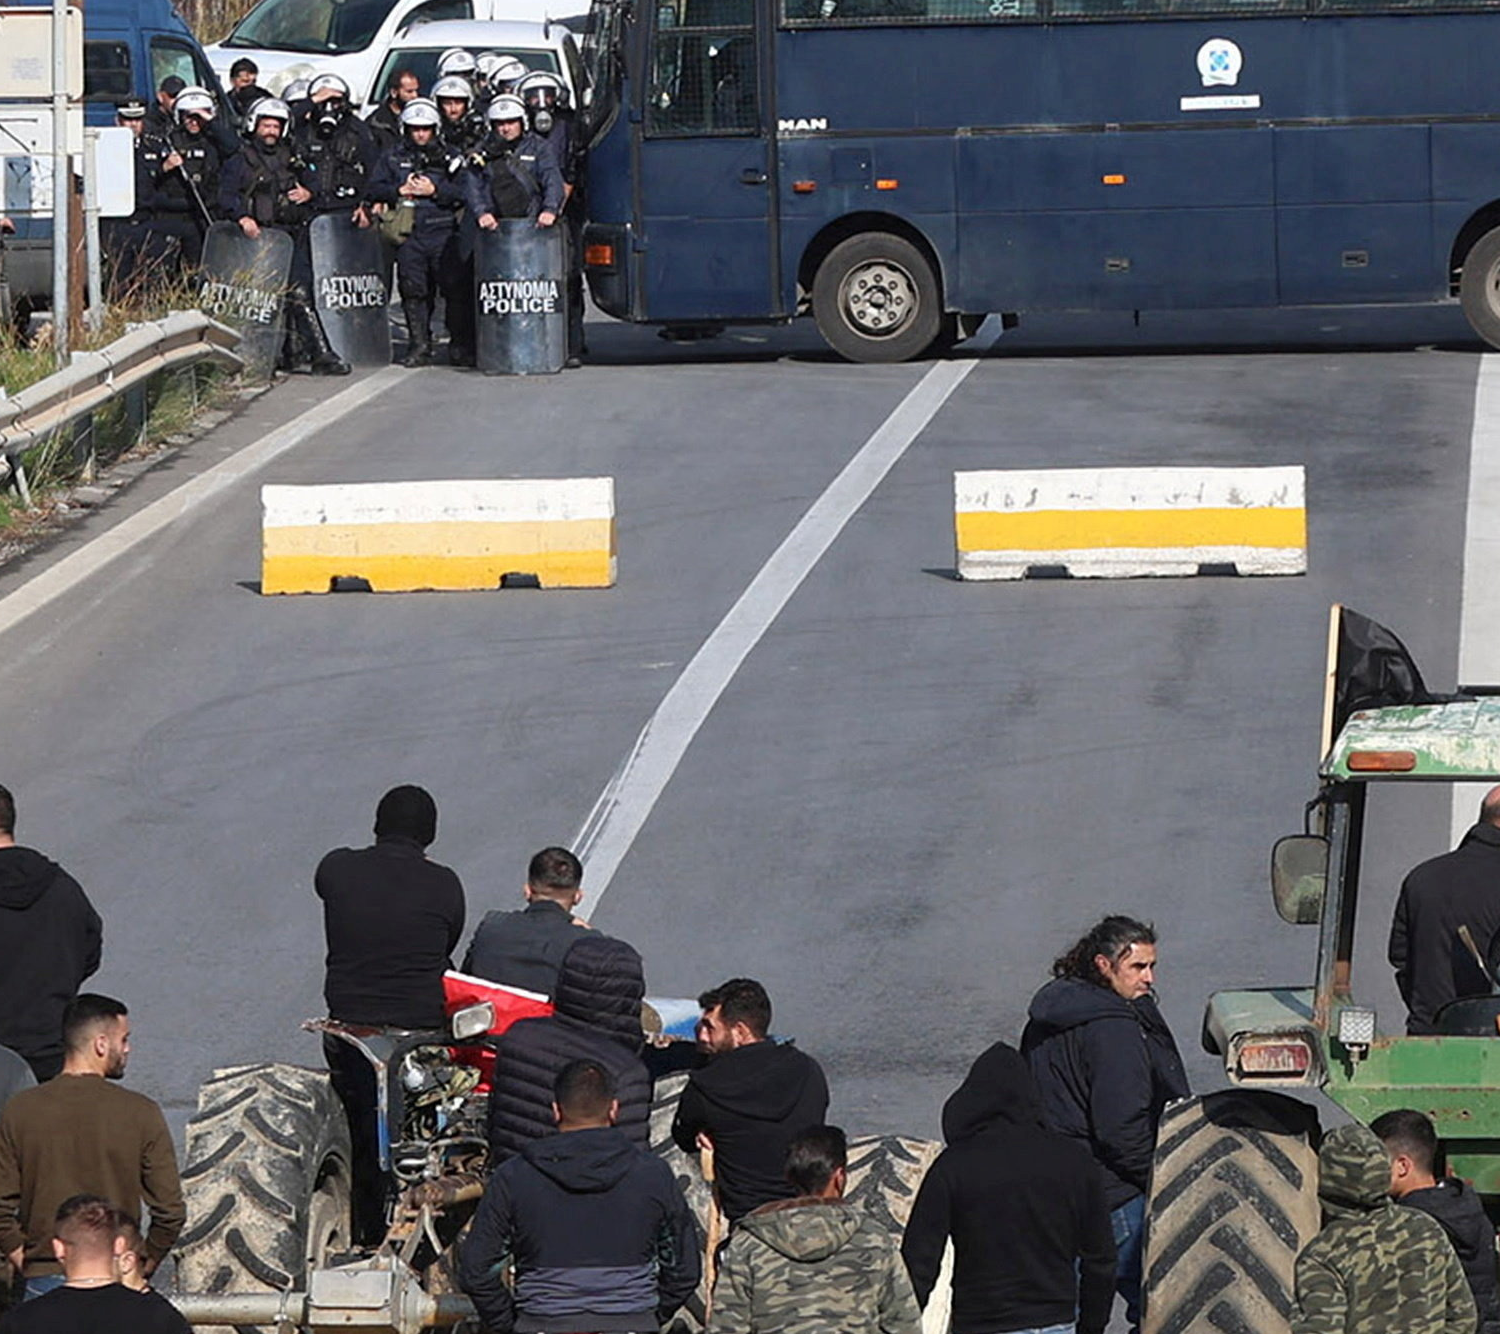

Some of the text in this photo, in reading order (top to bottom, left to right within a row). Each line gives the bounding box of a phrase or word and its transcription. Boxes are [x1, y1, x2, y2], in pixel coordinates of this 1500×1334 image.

[778, 118, 828, 131] MAN
[480, 280, 558, 300] ΑΣΤΥΝΟΜΙΑ
[326, 292, 384, 309] POLICE
[483, 298, 555, 314] POLICE
[202, 300, 272, 324] POLICE
